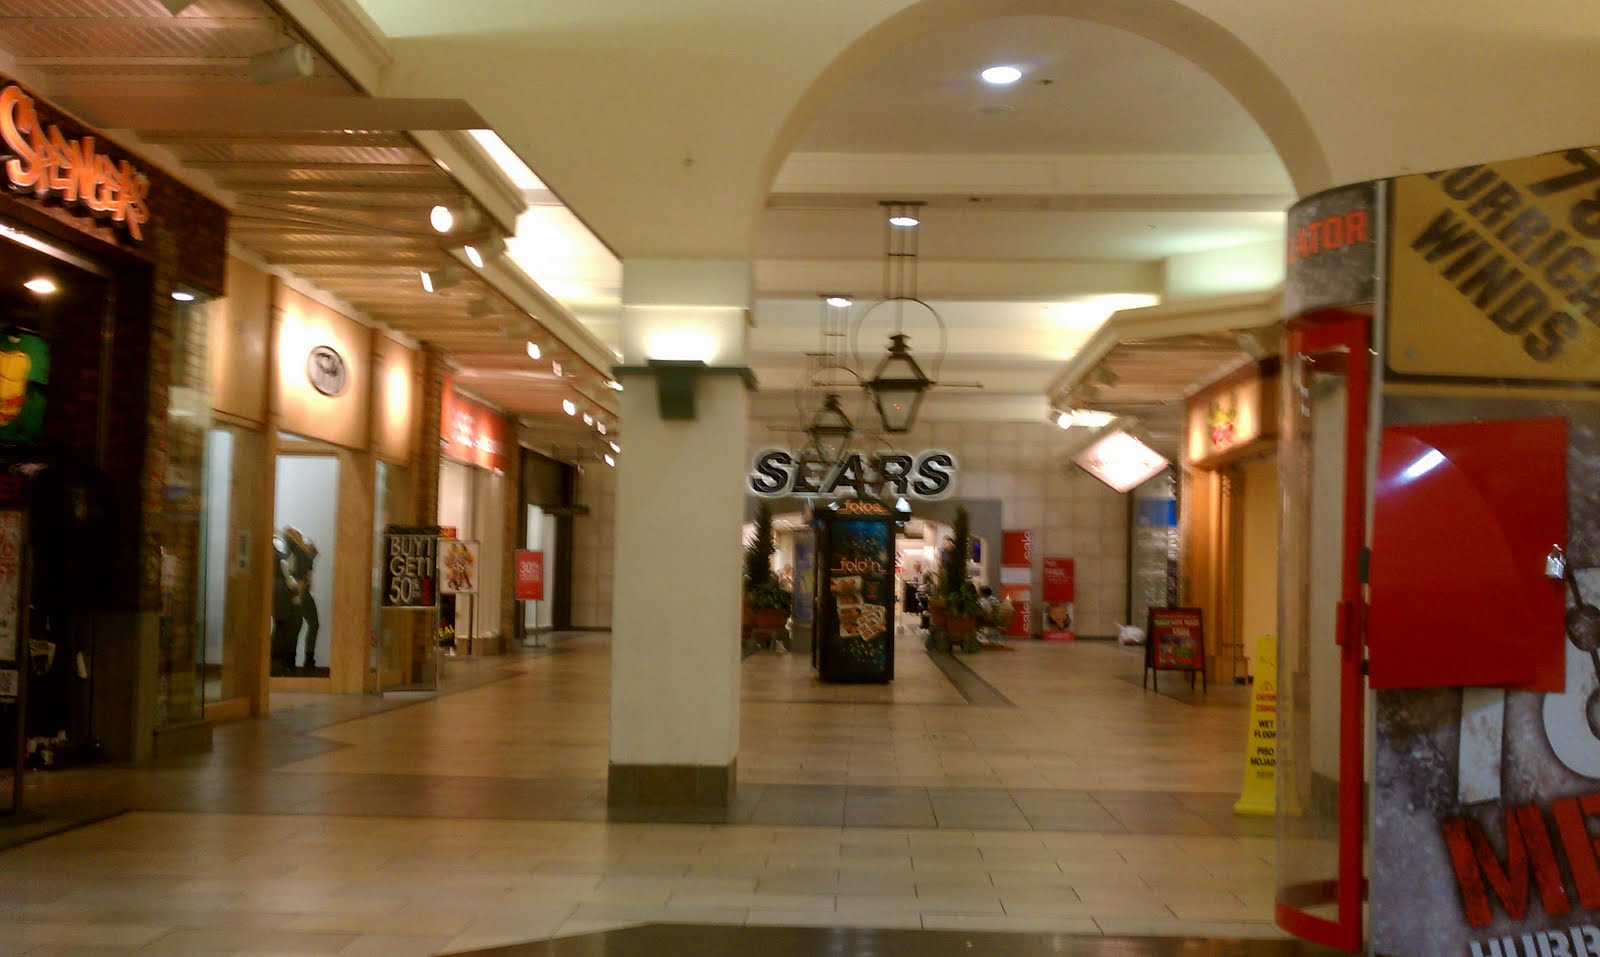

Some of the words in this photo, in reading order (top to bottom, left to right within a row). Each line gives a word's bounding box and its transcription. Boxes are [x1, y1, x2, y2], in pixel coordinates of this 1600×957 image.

[1409, 206, 1581, 362] WINDS
[751, 449, 956, 499] SEARS
[390, 536, 424, 555] BUY
[389, 556, 425, 576] GET
[1258, 720, 1274, 728] WET
[1250, 757, 1276, 767] MOJAD
